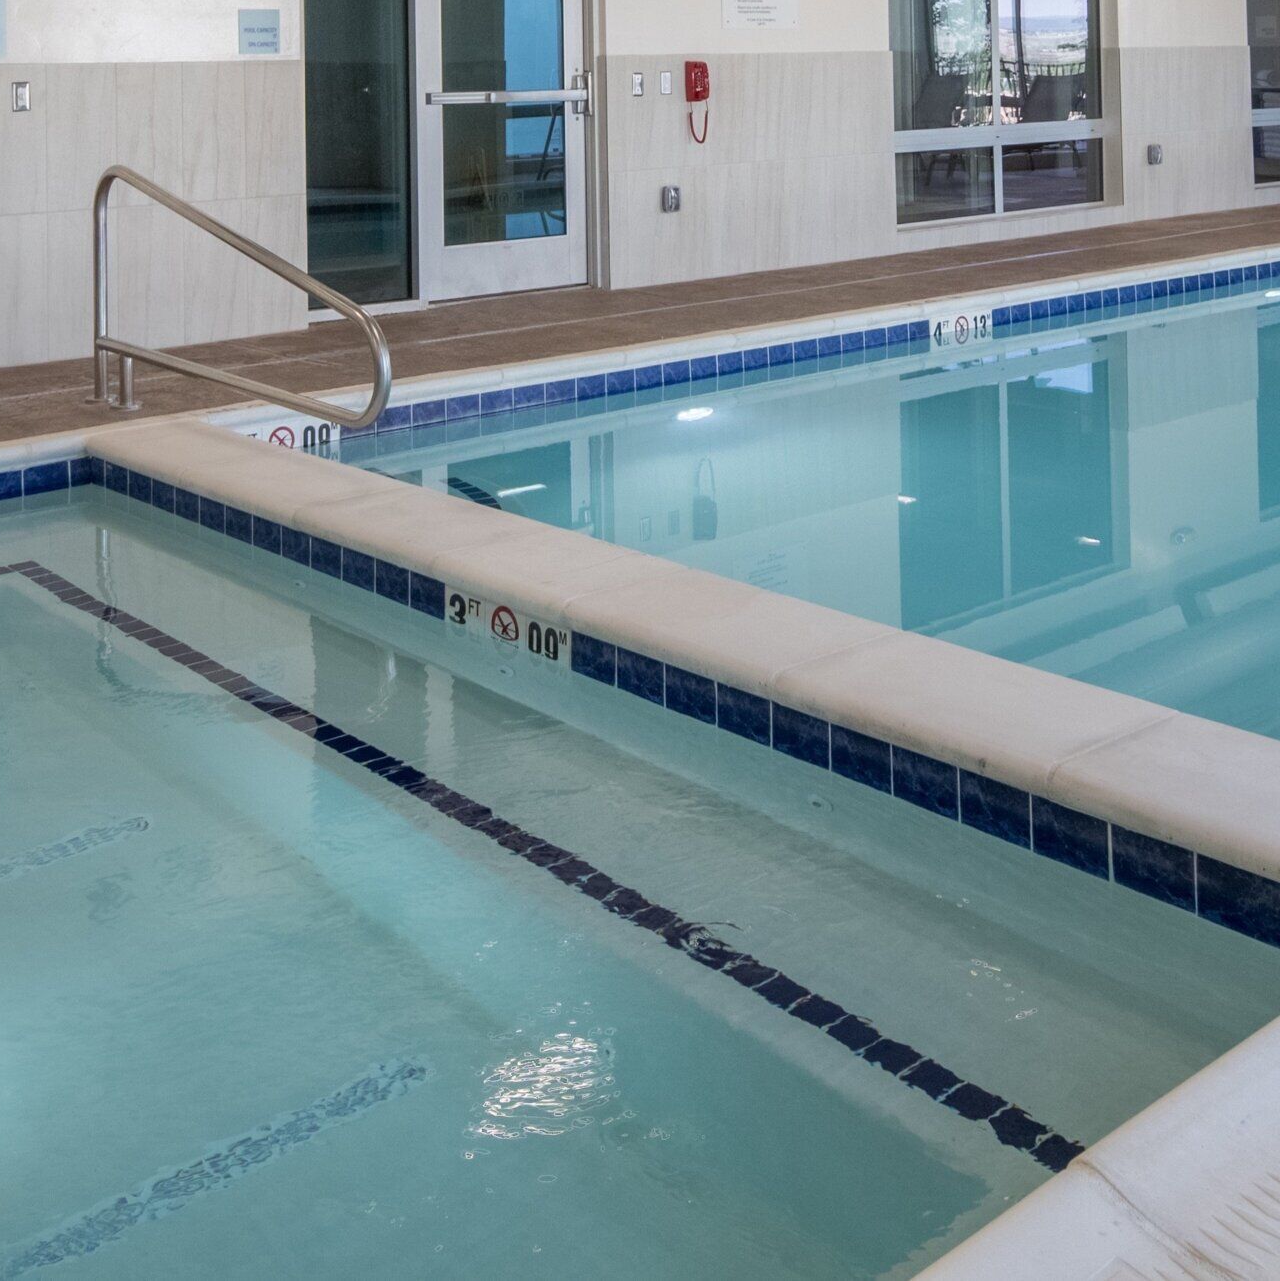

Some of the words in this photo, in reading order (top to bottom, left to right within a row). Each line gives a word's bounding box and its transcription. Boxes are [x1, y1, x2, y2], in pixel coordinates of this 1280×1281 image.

[449, 593, 467, 624] 3
[468, 598, 482, 617] FT
[558, 630, 568, 646] M
